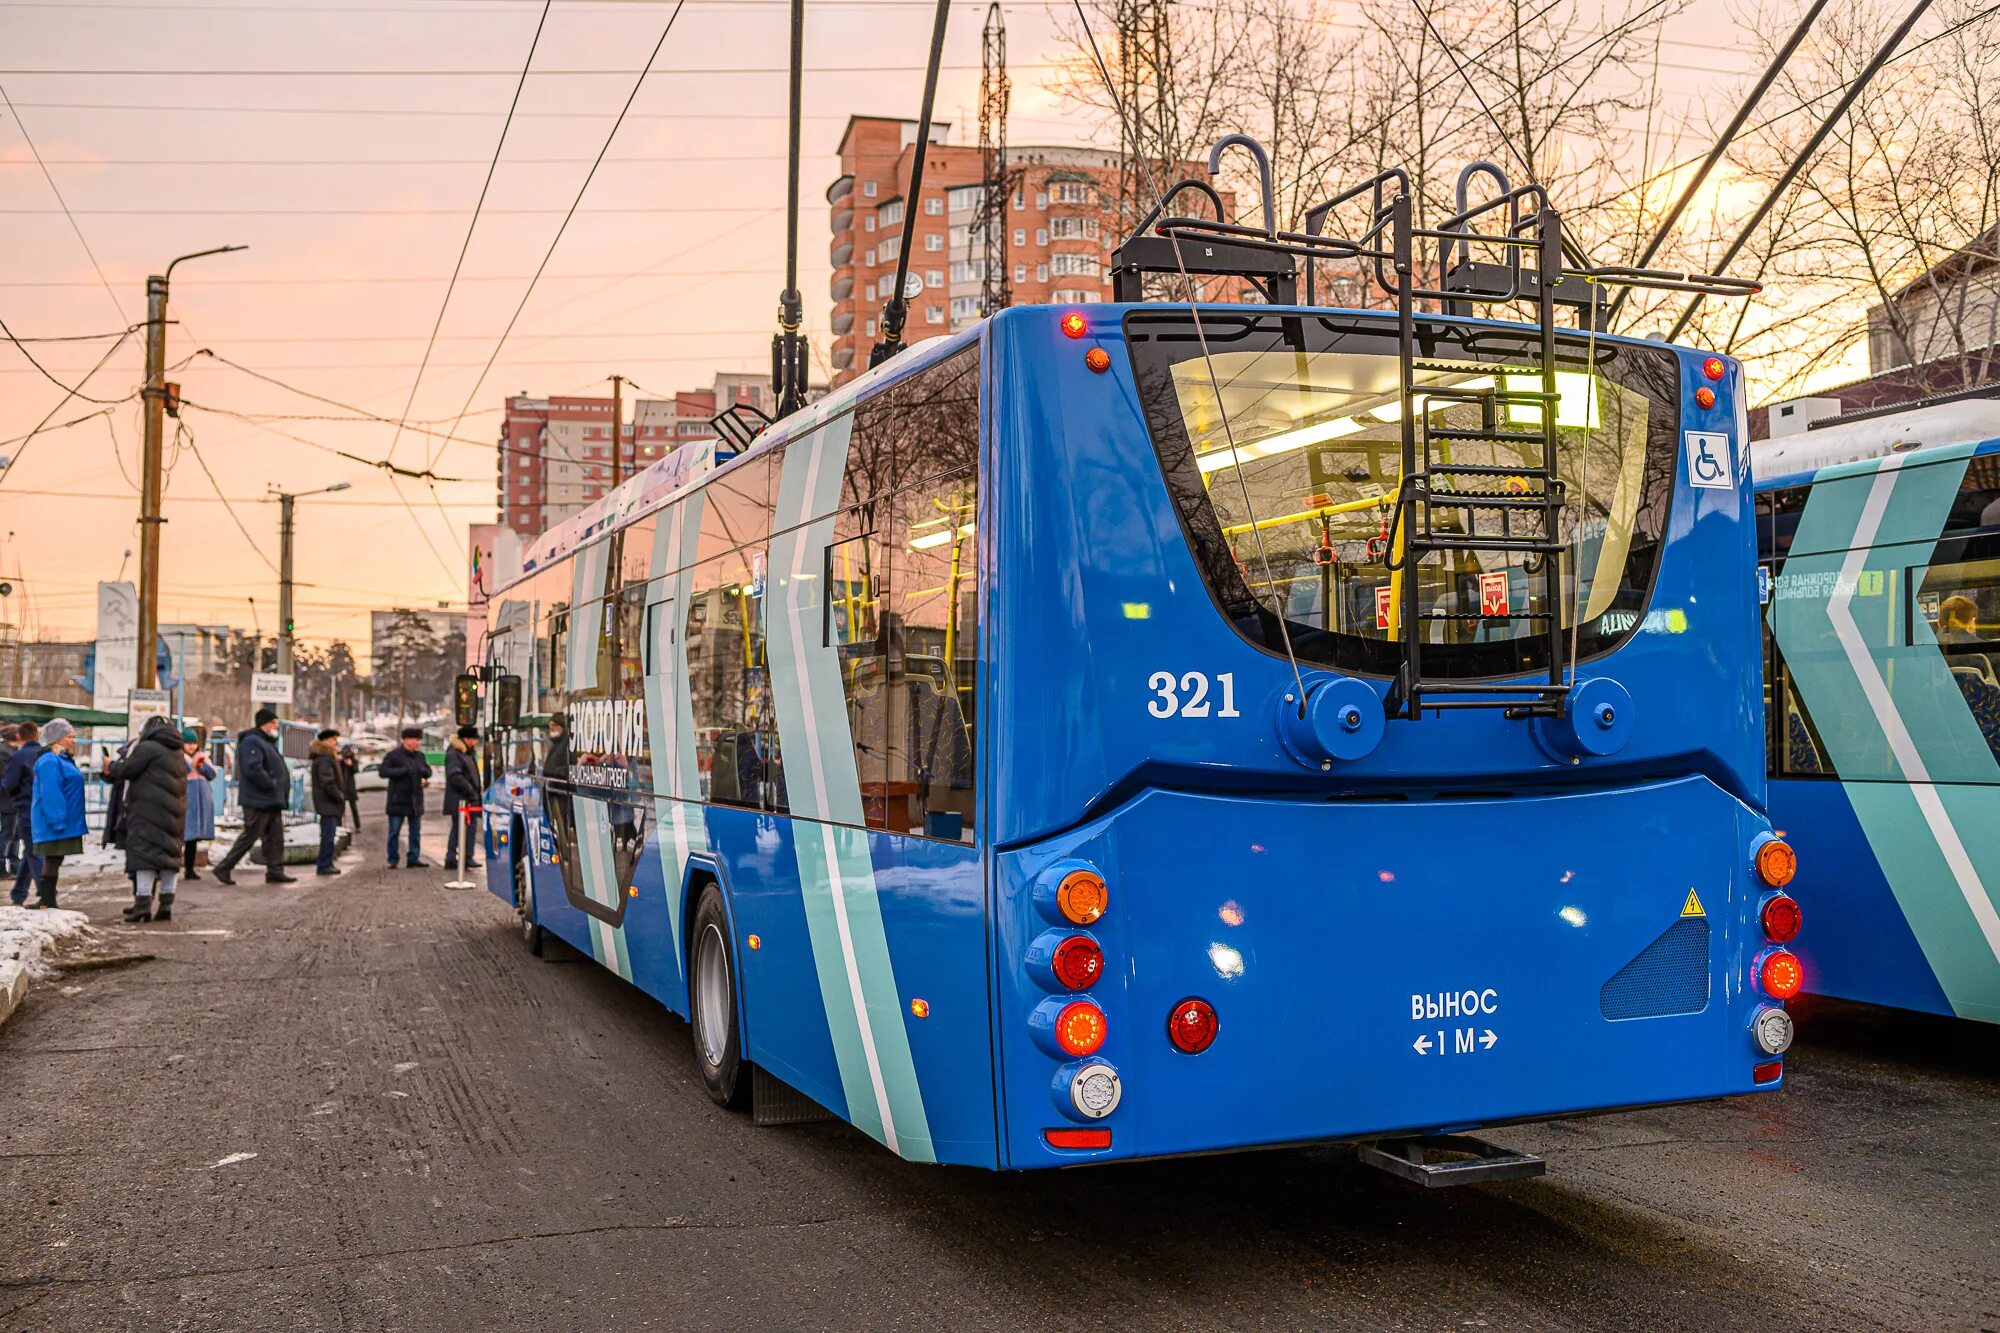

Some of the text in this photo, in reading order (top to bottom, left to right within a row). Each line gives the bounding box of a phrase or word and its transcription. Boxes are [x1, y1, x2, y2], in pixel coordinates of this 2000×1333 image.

[1147, 671, 1240, 719] 321
[569, 699, 644, 757] ЭКОЛОГИЯ
[1411, 988, 1498, 1020] ВЫНОС
[1437, 1027, 1475, 1055] 1 М
